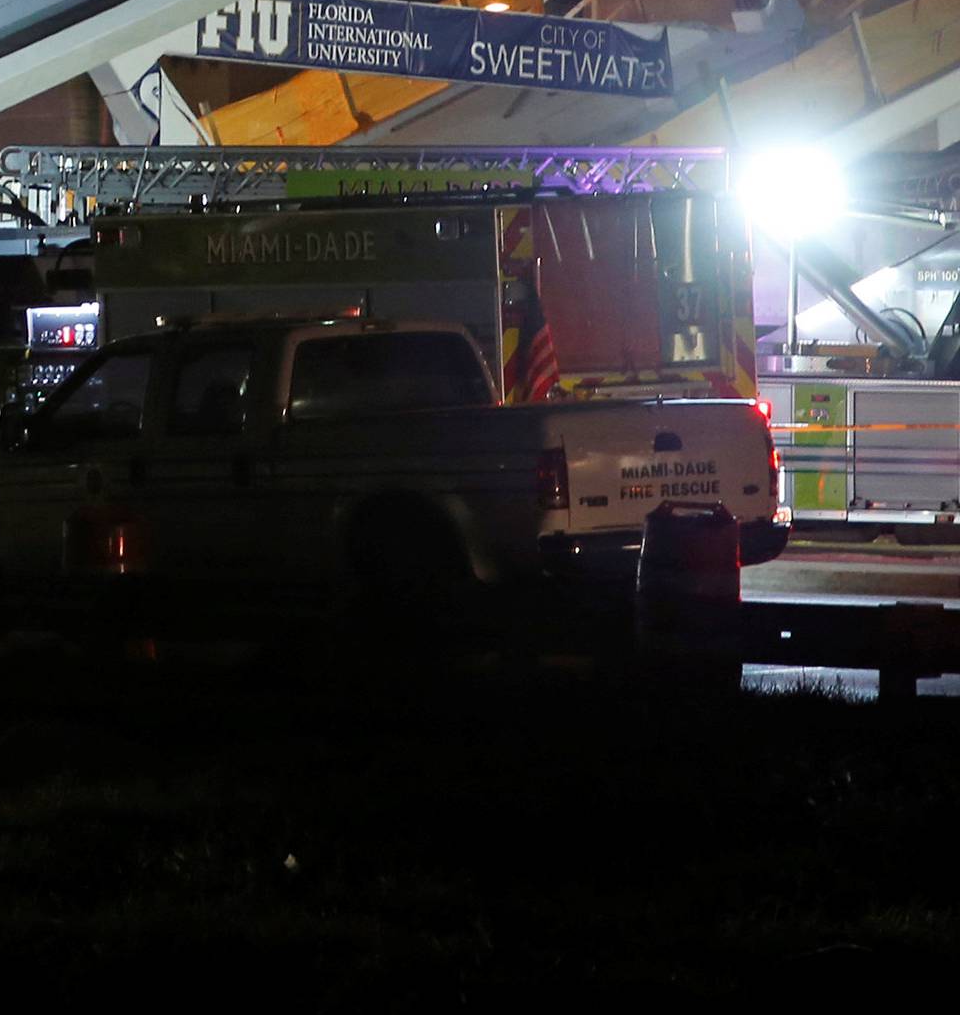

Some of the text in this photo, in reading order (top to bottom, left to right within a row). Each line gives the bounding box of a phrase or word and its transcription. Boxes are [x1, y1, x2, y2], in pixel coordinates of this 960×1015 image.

[308, 2, 375, 25] FLORIDA
[308, 22, 433, 51] INTERNATIONAL
[540, 23, 606, 50] CITY OF
[307, 42, 402, 68] UNIVERSITY
[469, 40, 667, 91] SWEETWATER
[207, 230, 377, 265] MIAMI-DADE
[676, 286, 702, 321] 37
[621, 460, 717, 480] MIAMI-DADE
[620, 480, 720, 500] FIRE RESCUE
